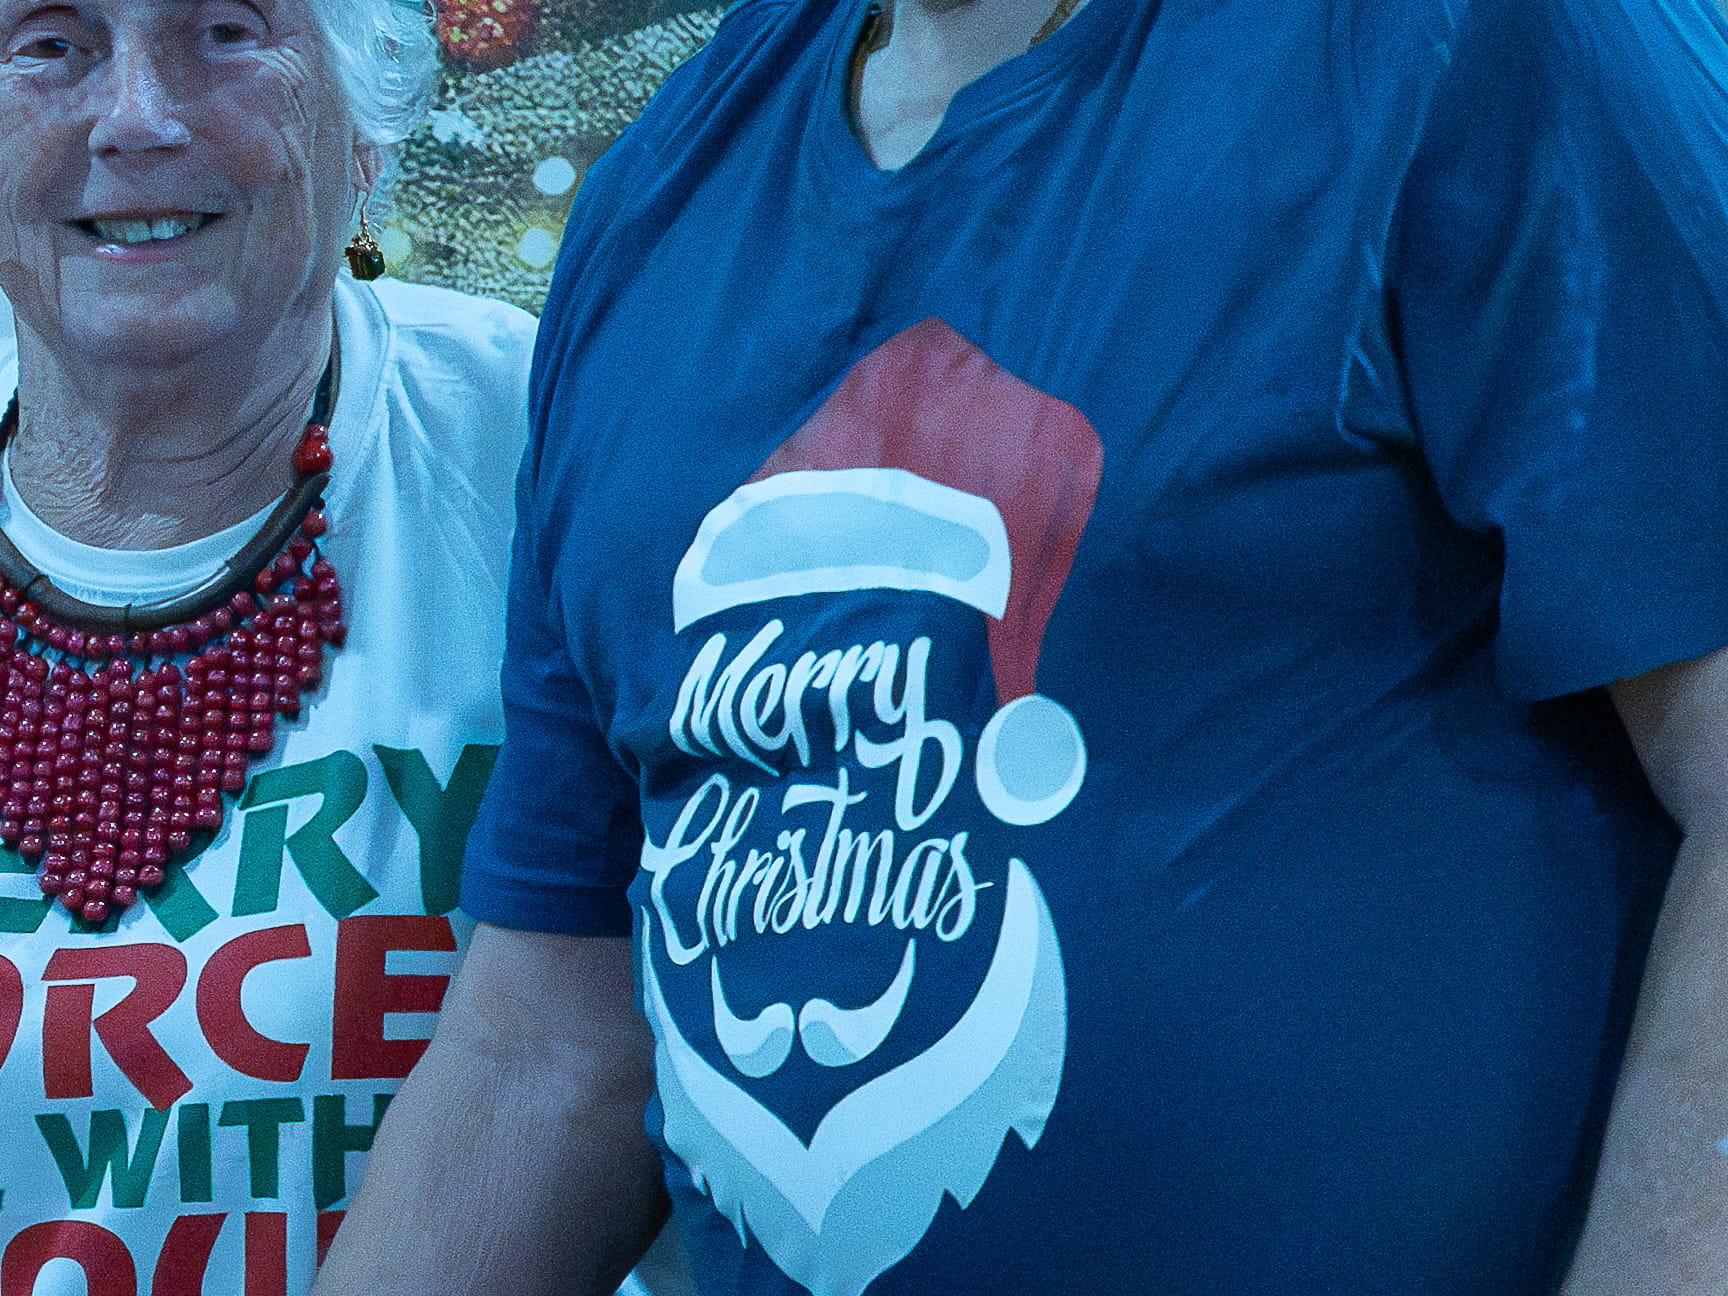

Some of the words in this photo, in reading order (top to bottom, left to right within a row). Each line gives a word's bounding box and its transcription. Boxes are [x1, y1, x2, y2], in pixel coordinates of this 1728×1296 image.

[669, 619, 964, 831] Merry
[641, 768, 994, 965] Christmas
[34, 1093, 396, 1210] WITH
